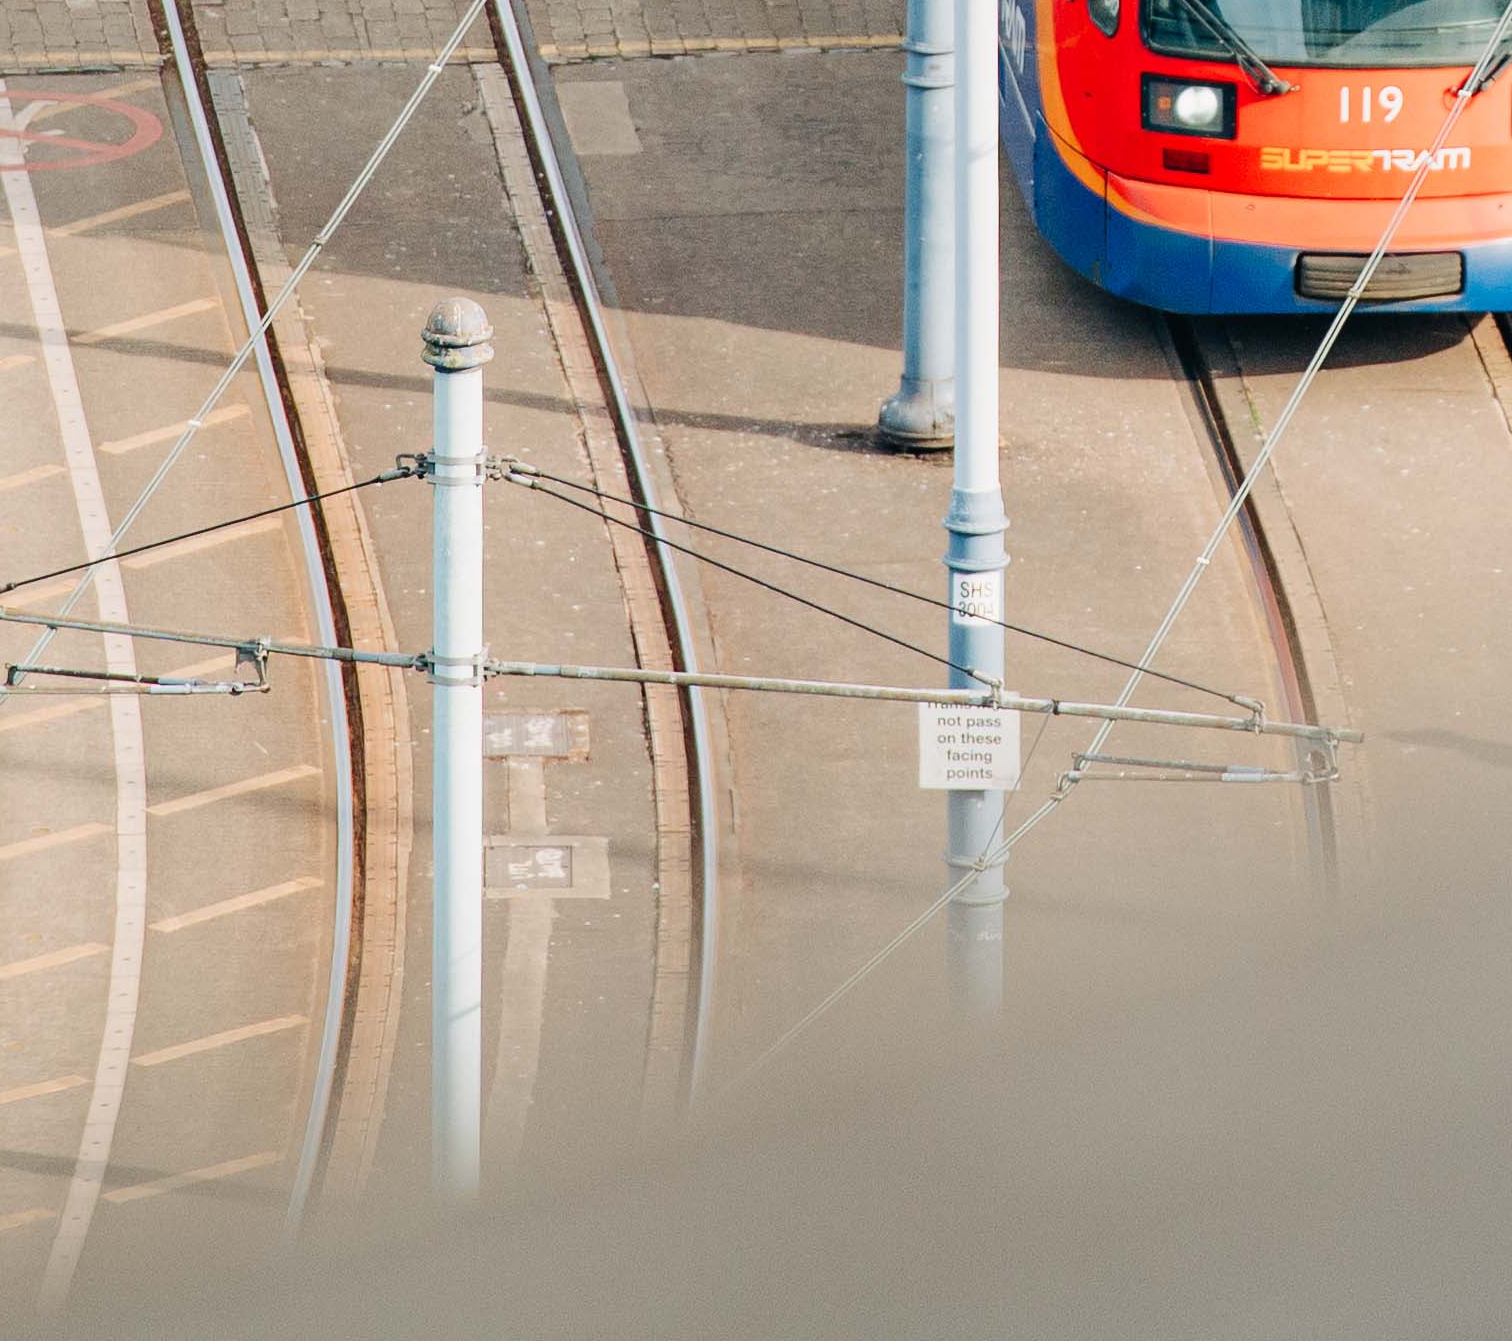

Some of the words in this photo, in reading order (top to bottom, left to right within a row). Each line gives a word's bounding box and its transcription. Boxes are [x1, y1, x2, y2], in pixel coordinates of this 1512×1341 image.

[1340, 85, 1404, 124] 119
[1260, 146, 1472, 173] SUPERTRAM
[960, 581, 994, 599] SHS
[938, 716, 961, 728] not
[966, 718, 1002, 730] pass
[937, 735, 957, 746] on
[961, 732, 1002, 746] these
[947, 750, 992, 764] facing
[946, 767, 993, 780] points
